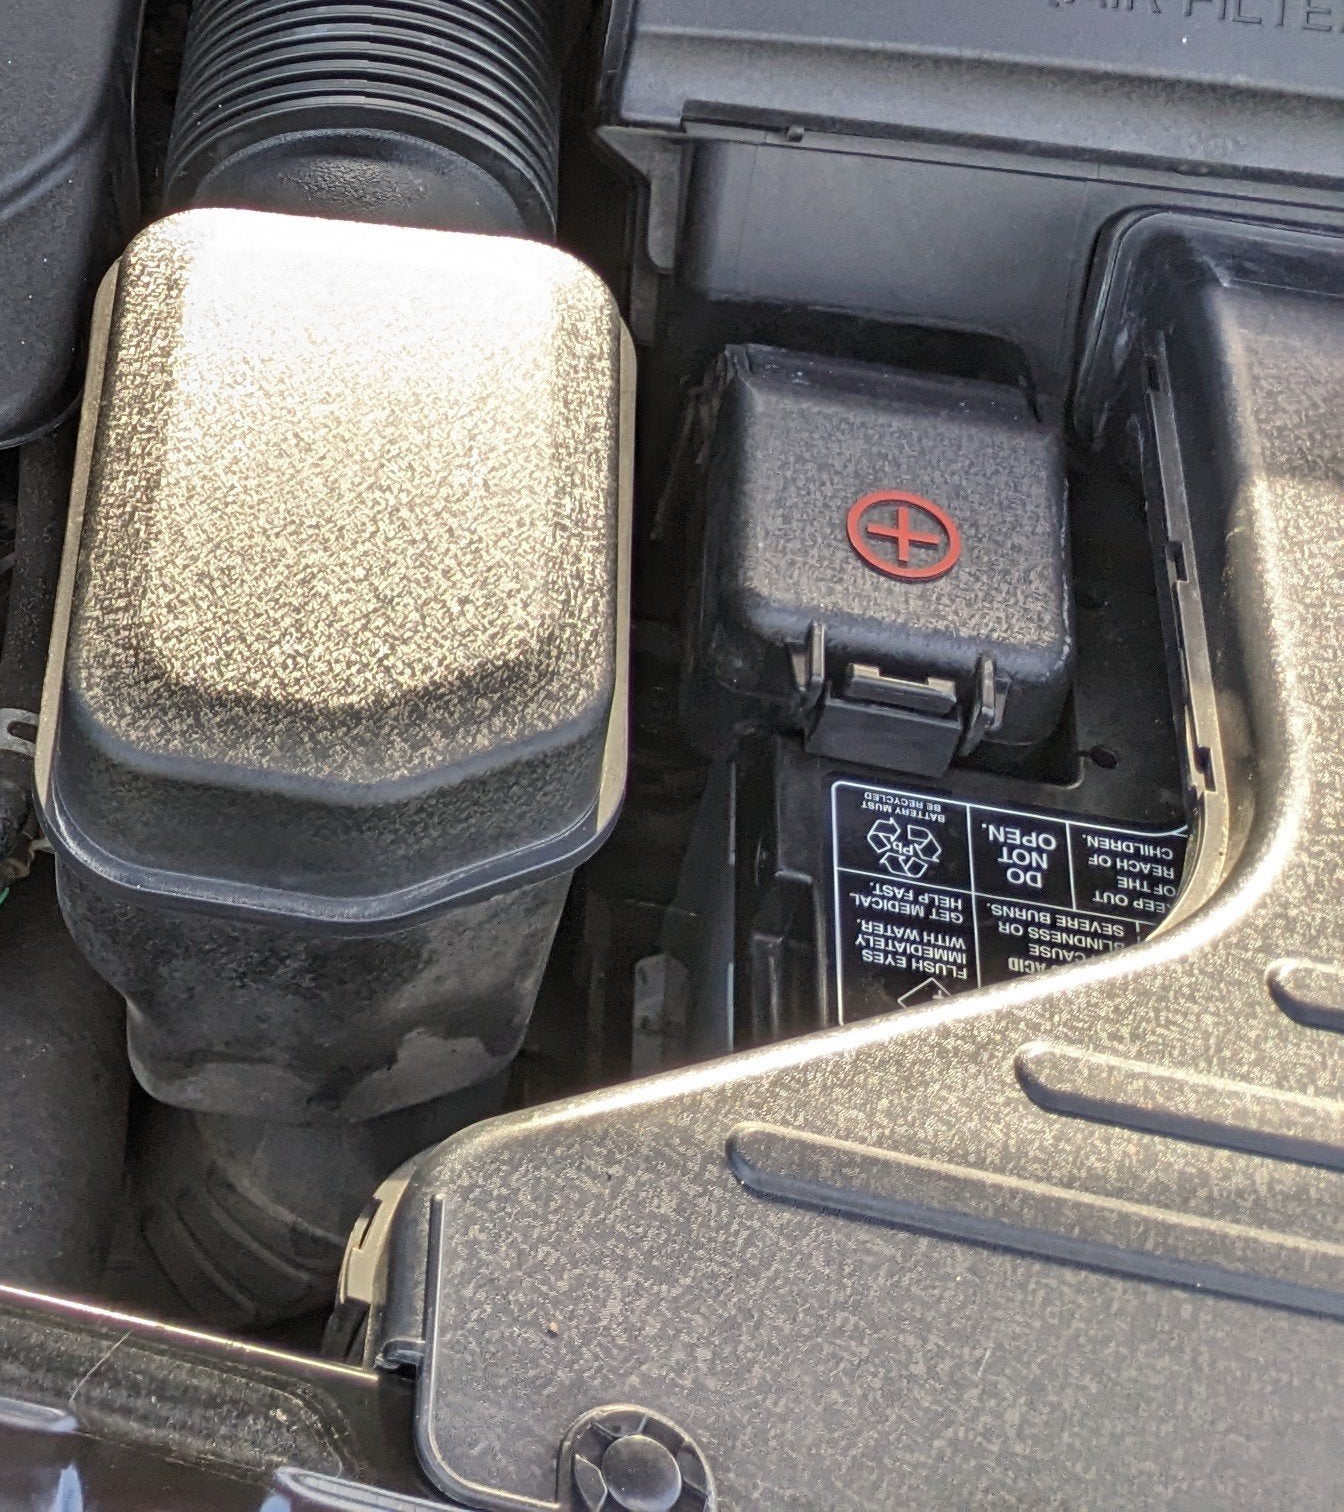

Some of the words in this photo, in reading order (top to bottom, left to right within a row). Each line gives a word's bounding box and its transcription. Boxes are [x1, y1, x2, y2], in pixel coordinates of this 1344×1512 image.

[861, 800, 892, 813] MUST
[864, 791, 924, 809] RECYCLED
[926, 802, 941, 812] BE
[895, 807, 946, 823] BATTERY
[981, 823, 1057, 850] OPEN.
[892, 841, 914, 855] Pb
[1082, 833, 1174, 860] CHILDREN.
[997, 846, 1048, 869] NOT
[1088, 853, 1111, 867] OF
[1116, 857, 1175, 879] REACH
[1006, 867, 1043, 889] DO
[1117, 875, 1152, 893] THE
[869, 881, 914, 901] FAST.
[1092, 889, 1129, 907] OUT
[1156, 884, 1176, 897] OF
[849, 892, 925, 917] MEDICAL
[918, 892, 962, 910] HELP
[1133, 899, 1170, 913] EEP
[929, 908, 964, 924] GET
[986, 902, 1052, 925] BURNS.
[856, 919, 920, 942] WATER.
[998, 920, 1024, 936] OR
[1055, 914, 1125, 937] SEVERE
[855, 934, 967, 964] IMMEDIATELY
[923, 931, 966, 950] WITH
[862, 949, 907, 968] EYES
[1028, 943, 1086, 963] CAUSE
[912, 958, 967, 979] FLUSH
[1008, 957, 1047, 974] ACID
